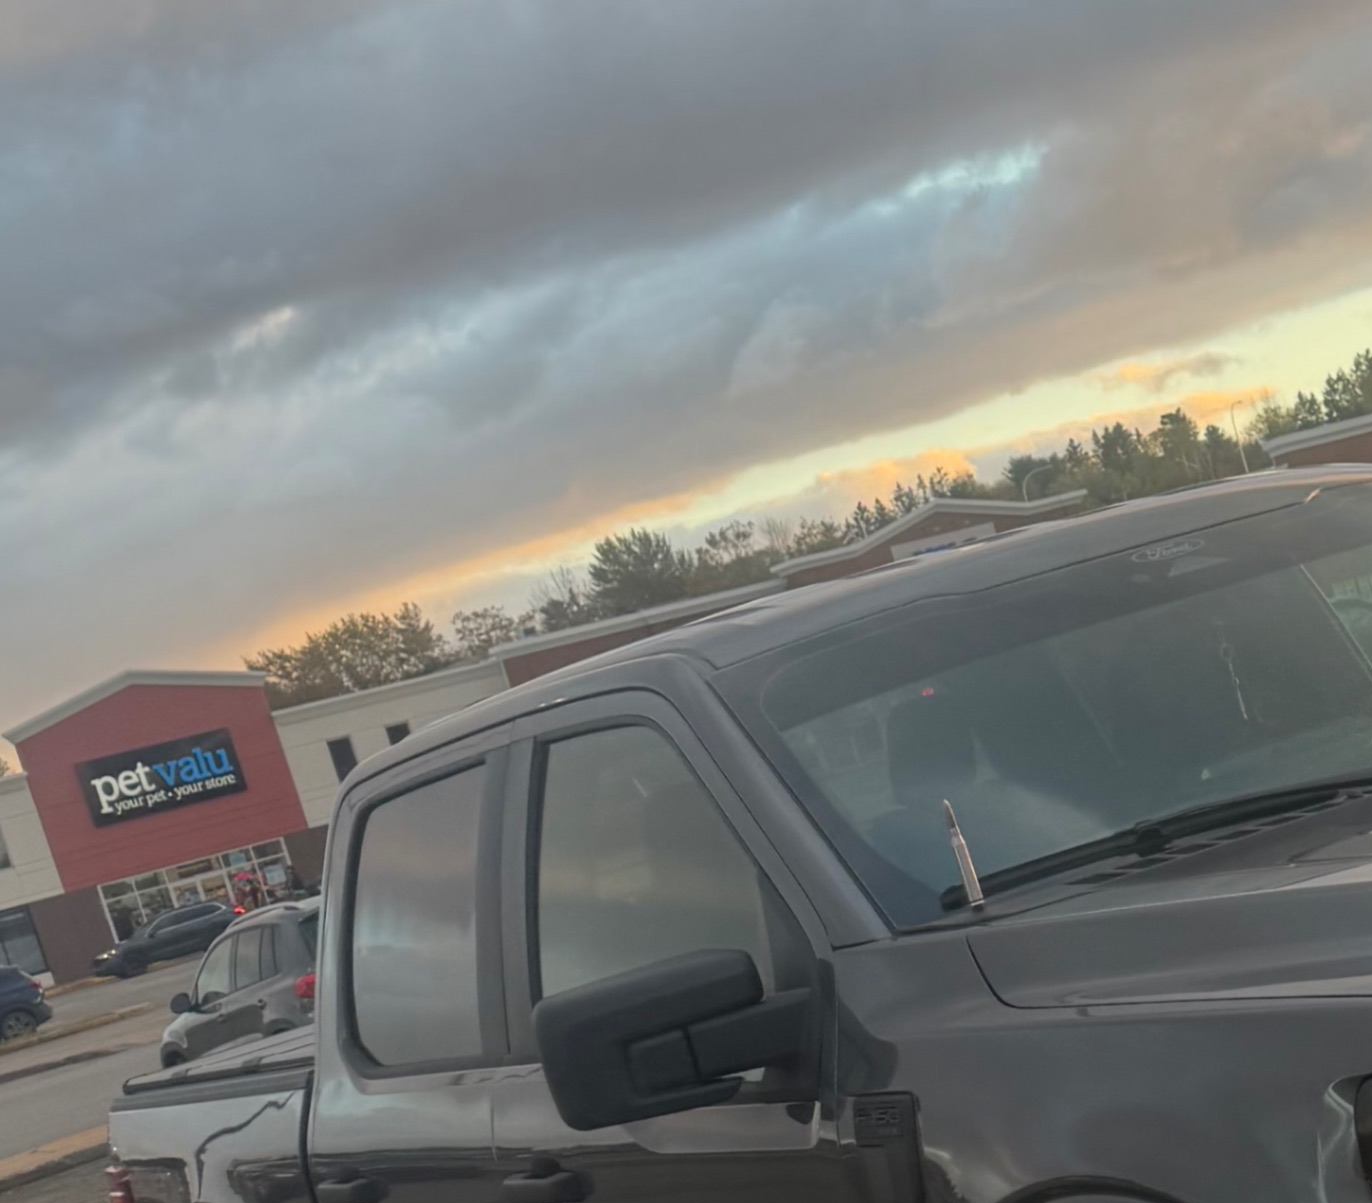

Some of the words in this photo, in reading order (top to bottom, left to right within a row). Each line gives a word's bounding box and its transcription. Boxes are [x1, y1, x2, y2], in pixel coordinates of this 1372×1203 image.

[91, 761, 156, 814] pet
[152, 746, 234, 787] valu
[114, 796, 145, 815] your
[146, 789, 167, 807] pet
[174, 781, 203, 800] your
[205, 773, 236, 790] store
